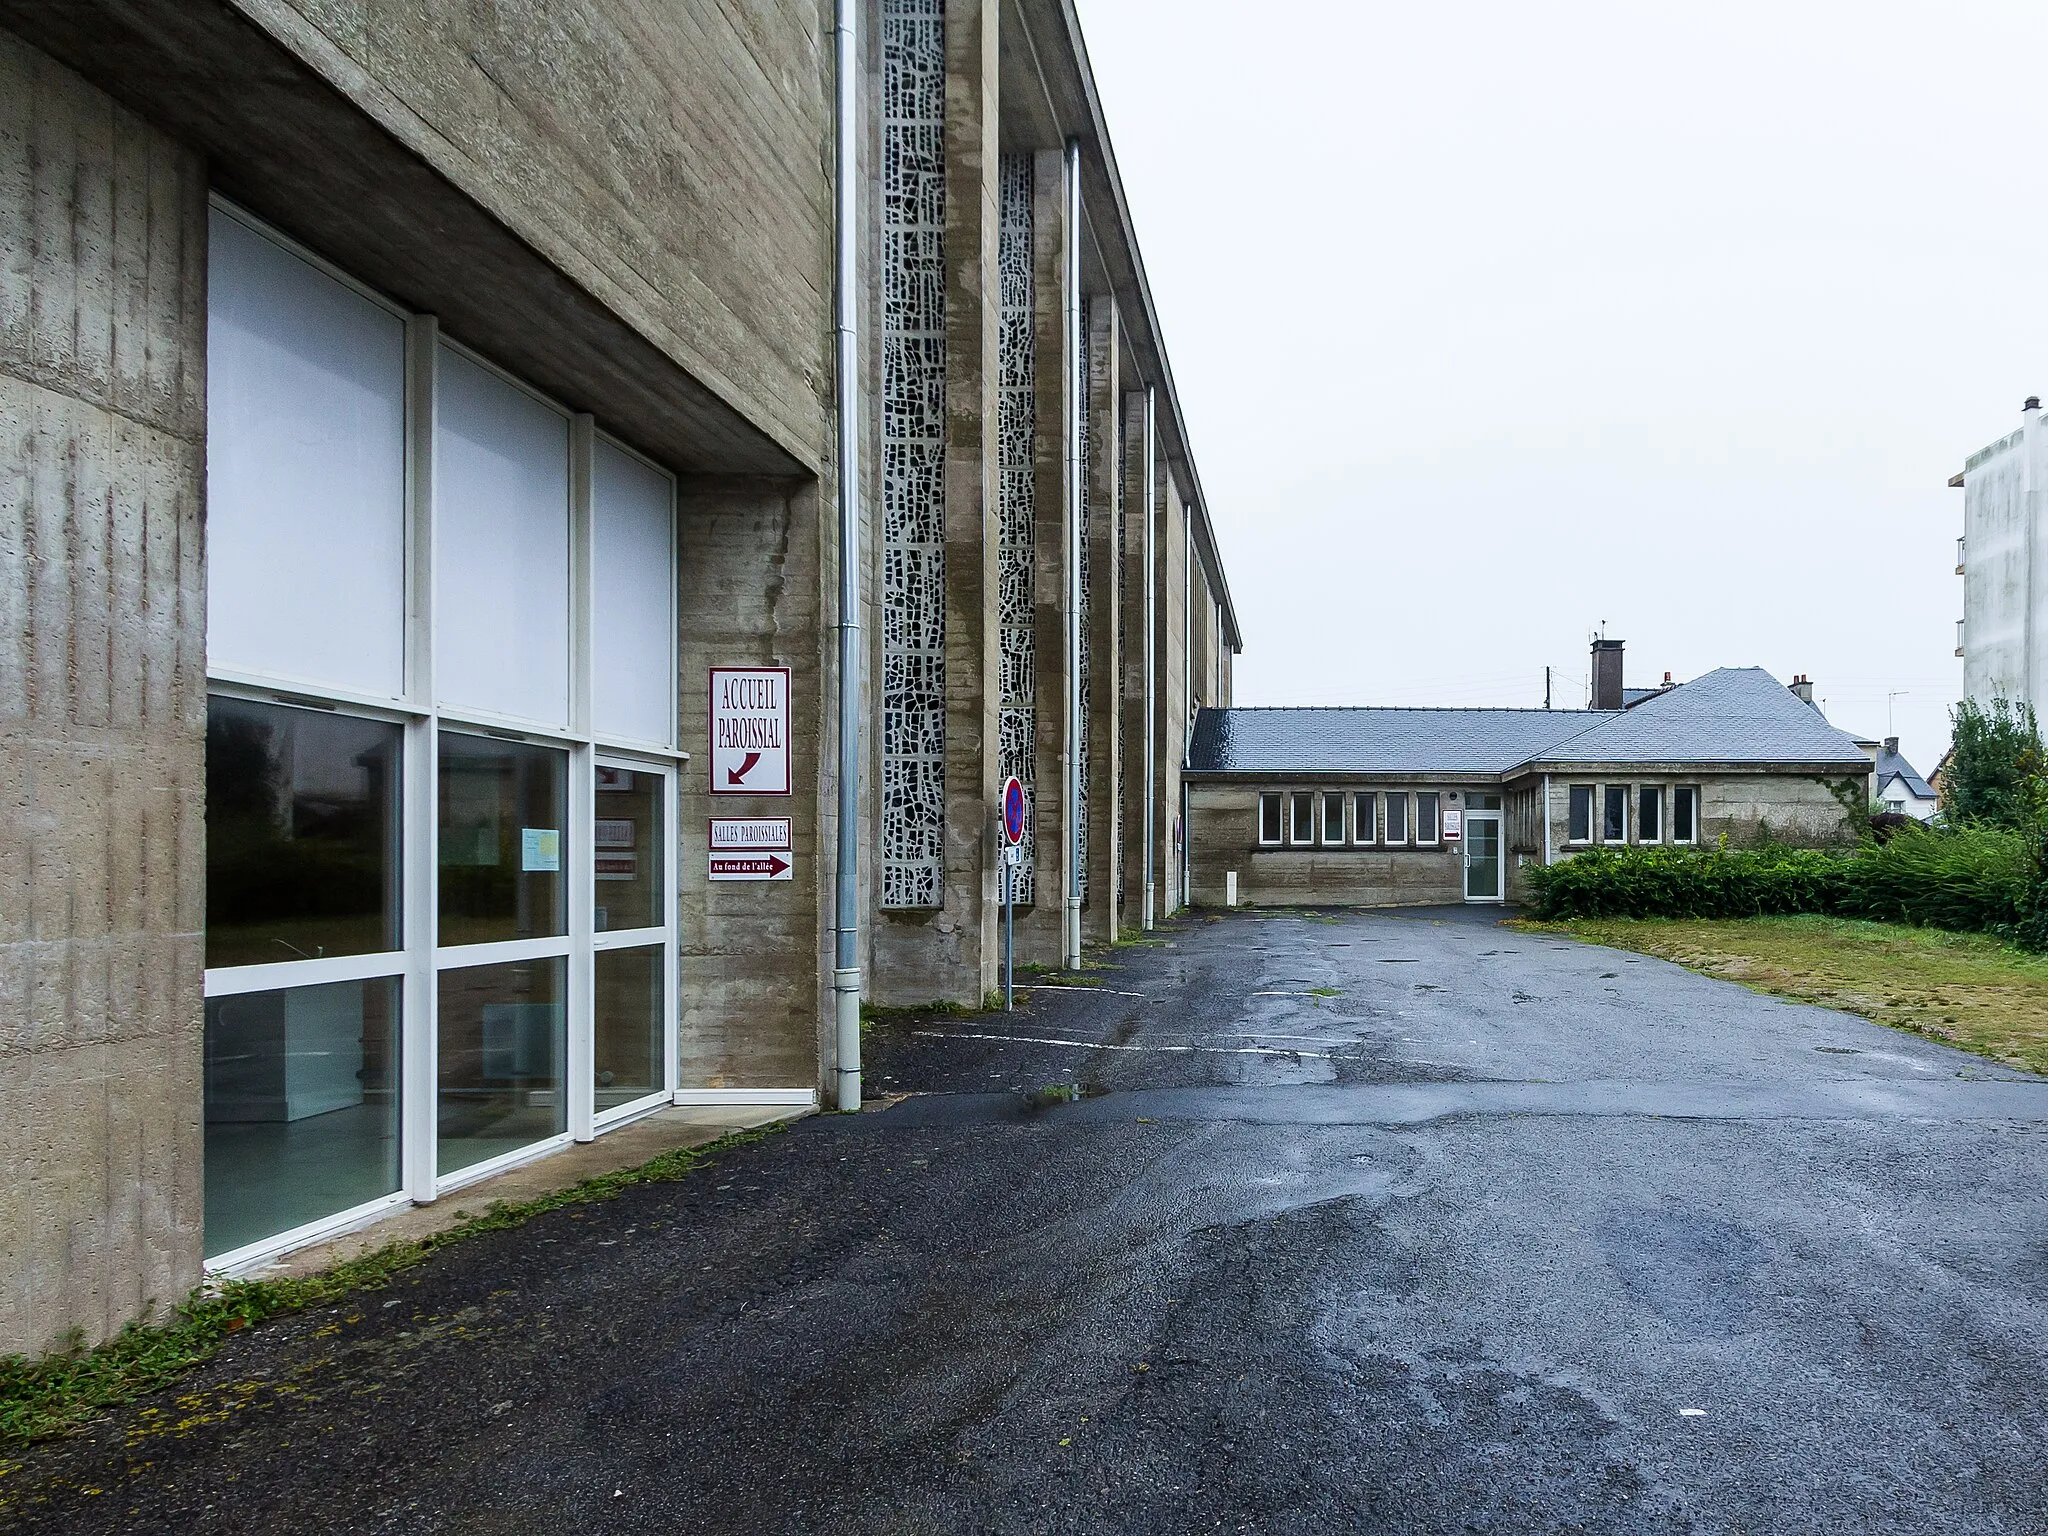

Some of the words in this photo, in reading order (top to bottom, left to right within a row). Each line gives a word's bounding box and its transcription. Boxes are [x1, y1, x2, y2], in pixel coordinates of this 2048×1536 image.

[721, 678, 777, 710] ACCUEIL
[718, 717, 782, 749] PAROISSIAL
[714, 825, 738, 842] SALLES
[741, 825, 787, 842] PAROISSIALES
[713, 862, 723, 871] Au
[724, 862, 740, 871] fond
[741, 862, 751, 871] de
[752, 862, 773, 871] l'allée
